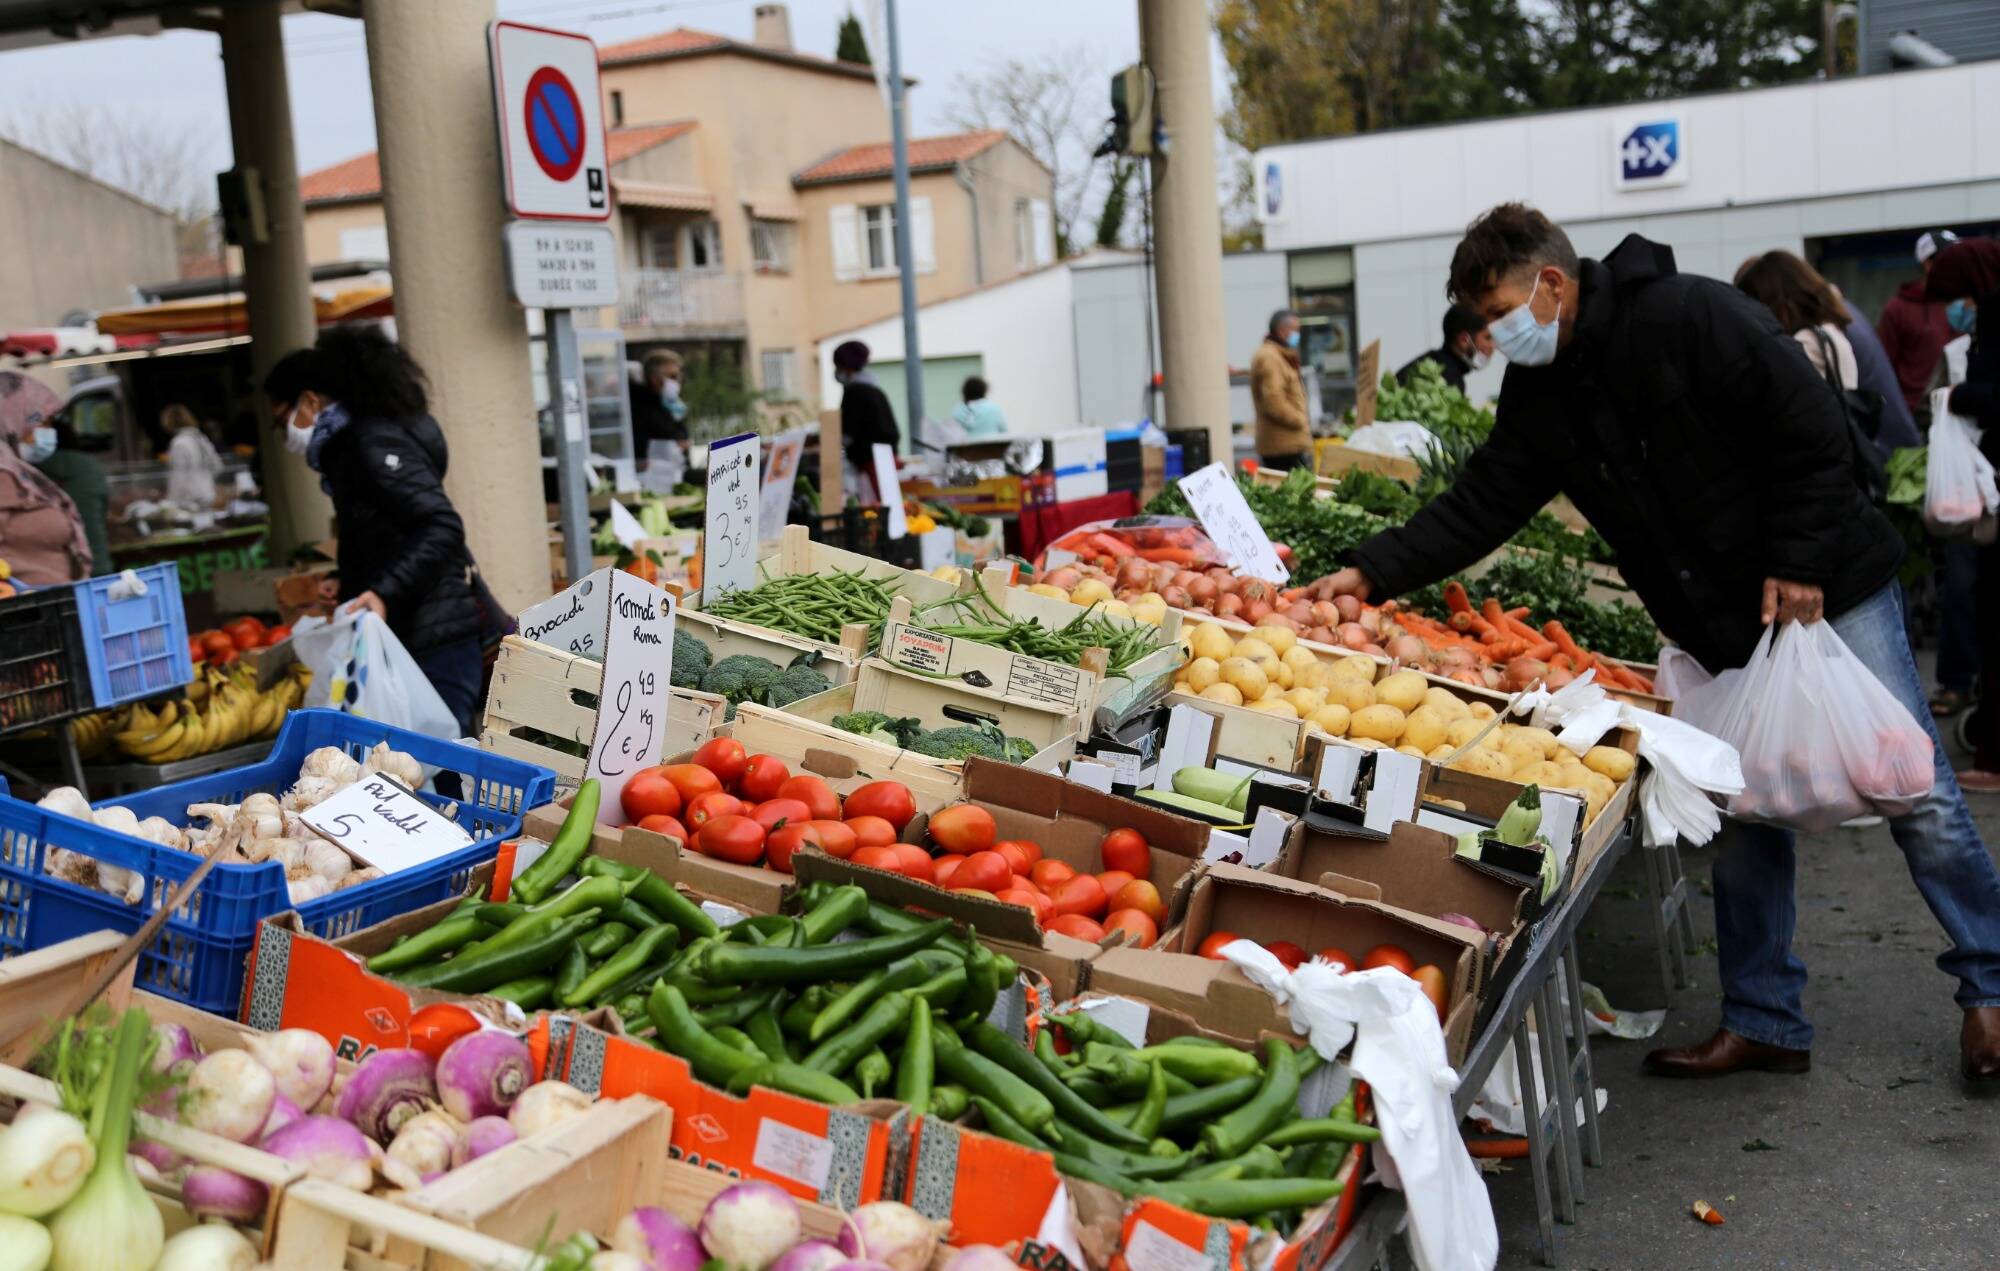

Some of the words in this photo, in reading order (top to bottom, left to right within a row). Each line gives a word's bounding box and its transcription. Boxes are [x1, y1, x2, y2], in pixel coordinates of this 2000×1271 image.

[716, 512, 733, 568] 3
[633, 625, 662, 645] Roma
[639, 670, 655, 696] 49
